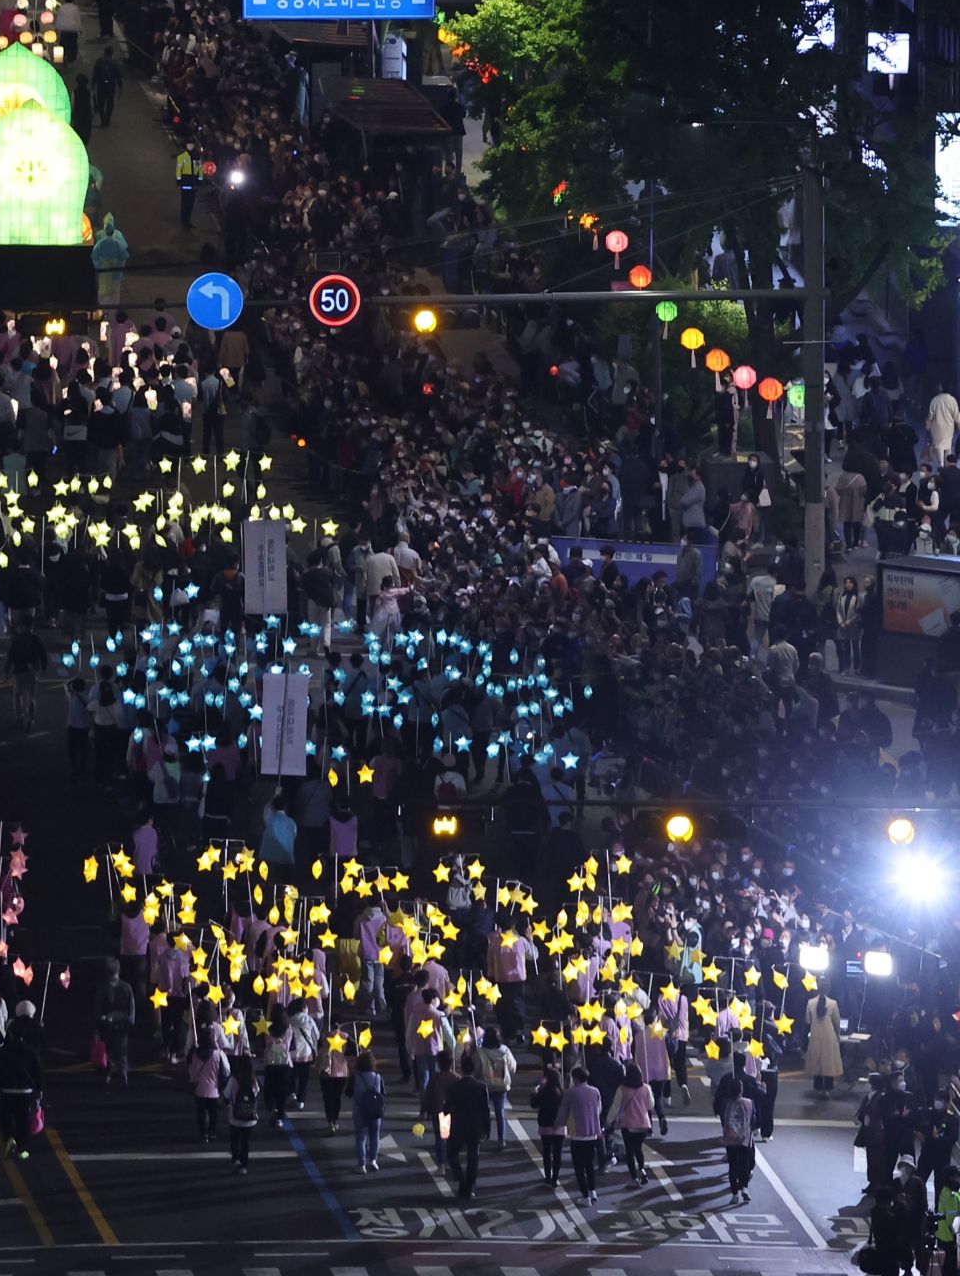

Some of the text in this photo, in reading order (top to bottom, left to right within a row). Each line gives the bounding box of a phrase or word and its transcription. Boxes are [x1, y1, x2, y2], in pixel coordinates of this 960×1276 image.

[321, 288, 349, 312] 50
[348, 1208, 580, 1242] 청계2가
[609, 1209, 799, 1245] 광화문
